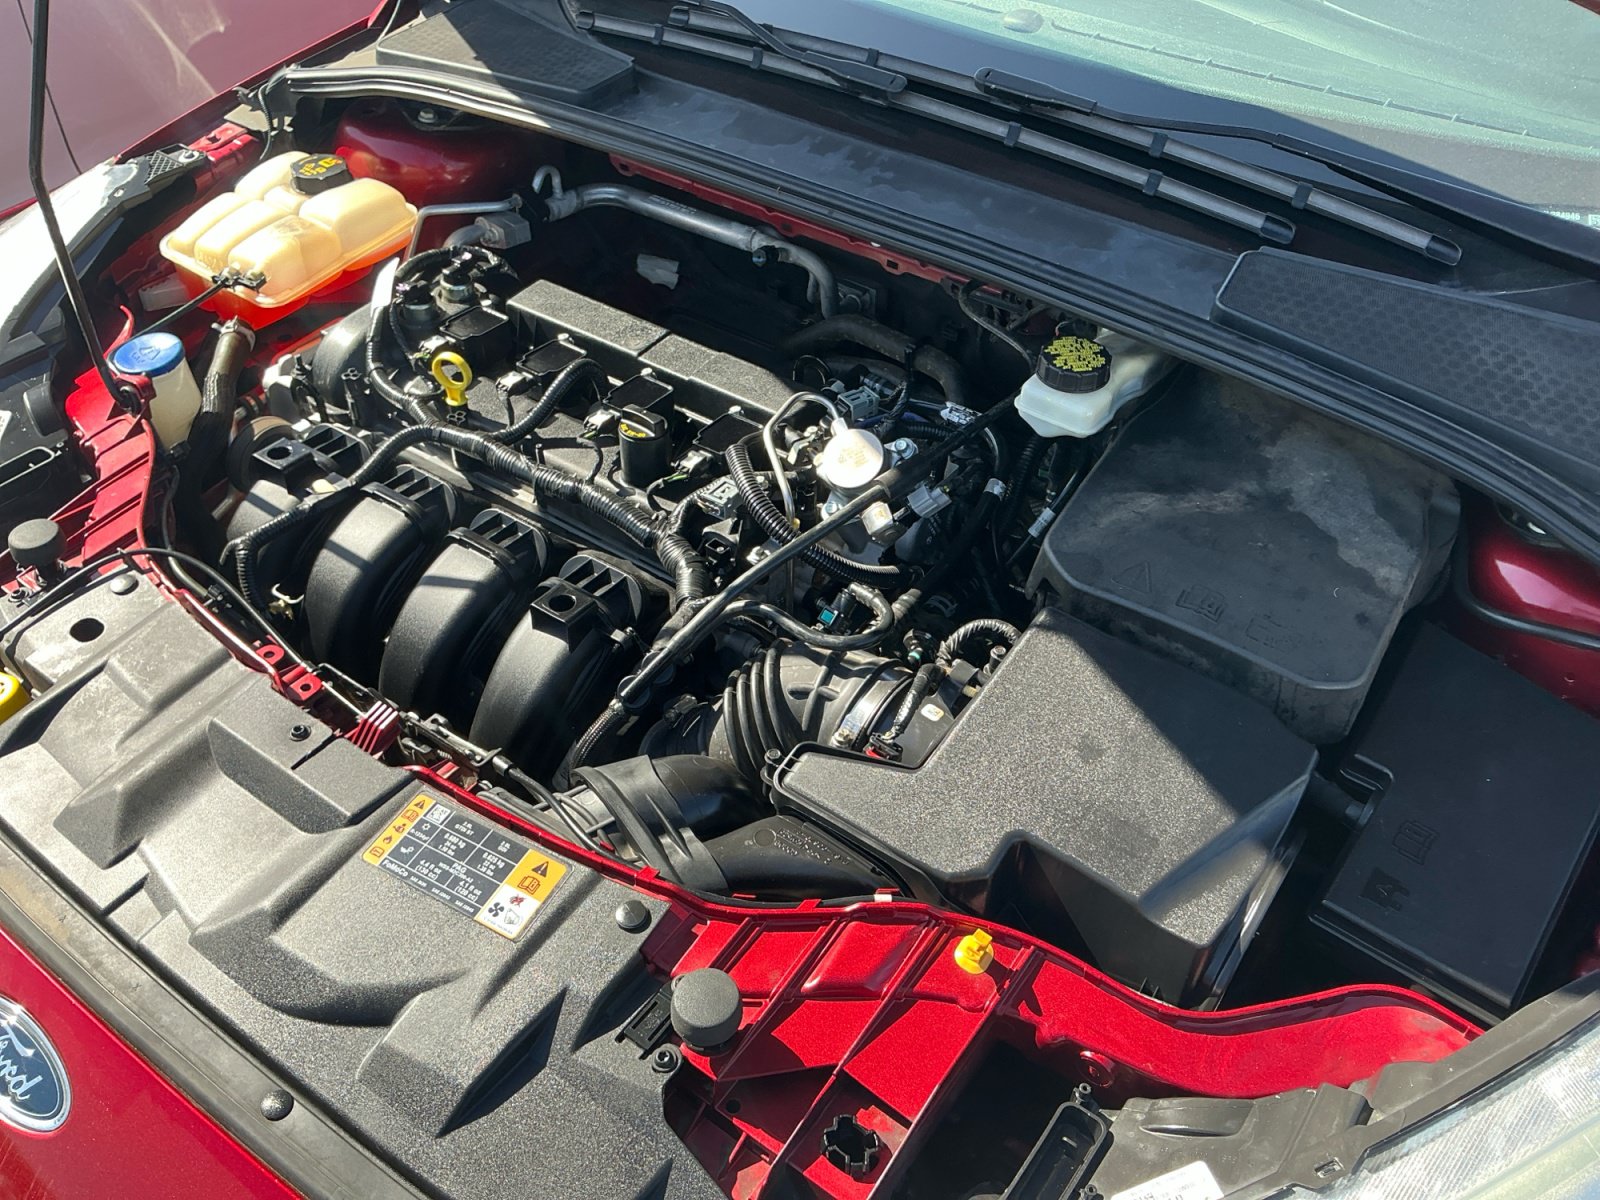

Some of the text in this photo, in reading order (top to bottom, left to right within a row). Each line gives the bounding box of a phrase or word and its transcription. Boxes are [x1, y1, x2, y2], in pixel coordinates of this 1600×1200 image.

[419, 859, 430, 867] 4.4
[381, 859, 409, 877] FoMoCo
[452, 863, 467, 873] PAG
[427, 871, 439, 880] cc)
[458, 880, 469, 888] 4.1
[466, 892, 479, 902] cc)
